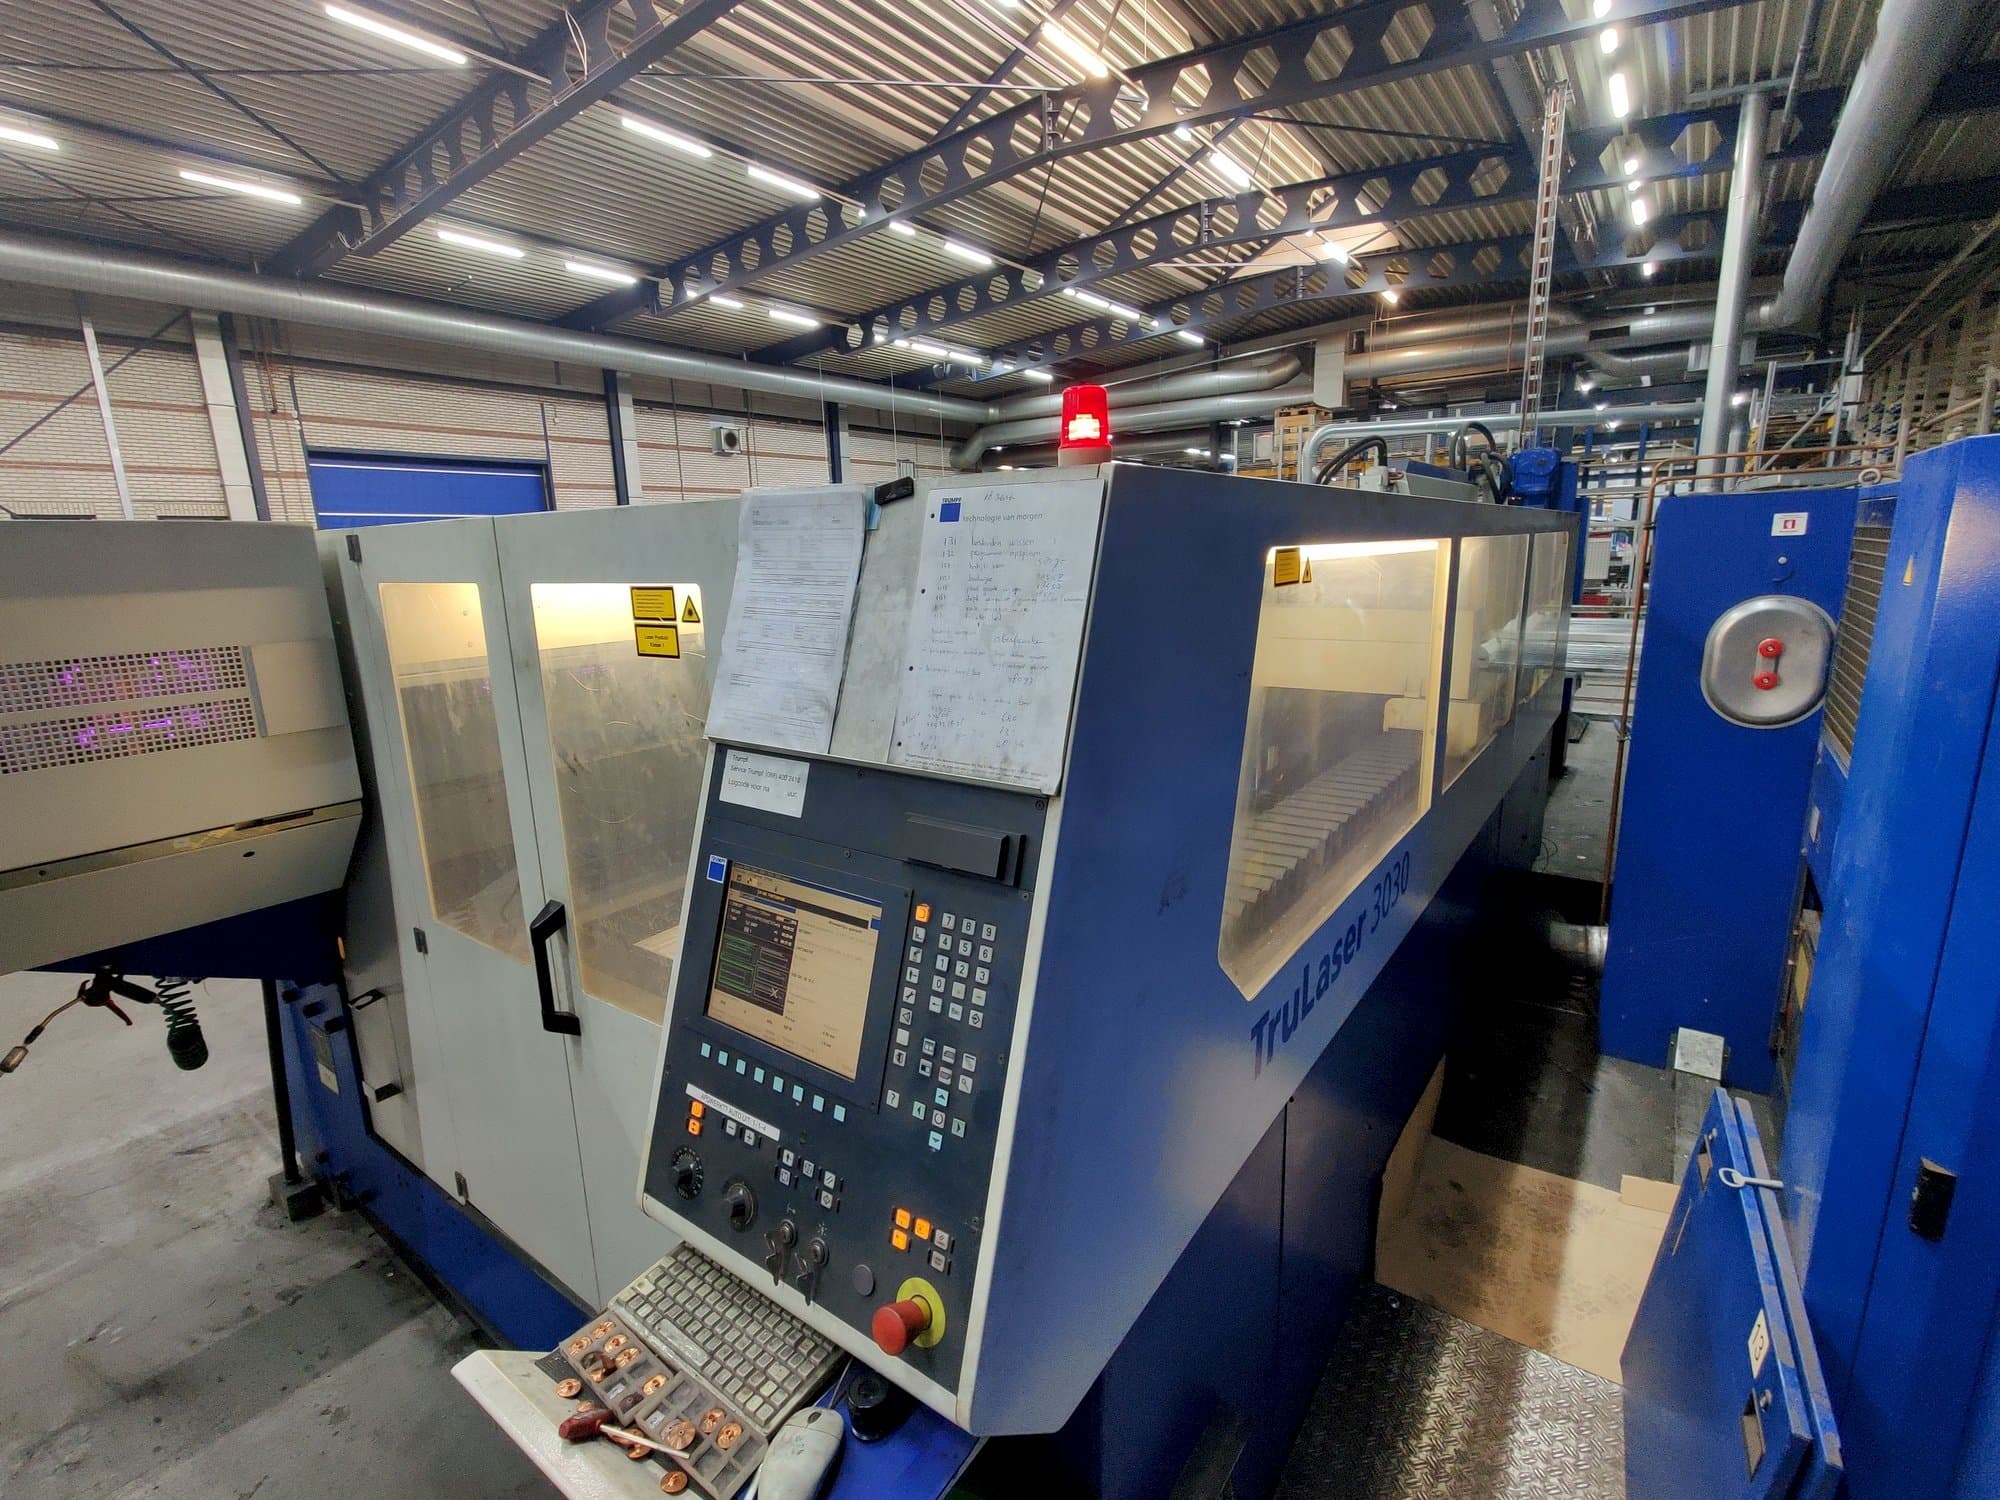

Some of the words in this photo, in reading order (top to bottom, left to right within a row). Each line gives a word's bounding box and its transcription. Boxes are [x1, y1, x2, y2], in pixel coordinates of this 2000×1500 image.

[963, 513, 1001, 523] technologie
[1016, 513, 1043, 522] morgen
[1251, 909, 1367, 1081] TruLaser
[1371, 851, 1411, 934] 3030
[1752, 1324, 1764, 1361] 13
